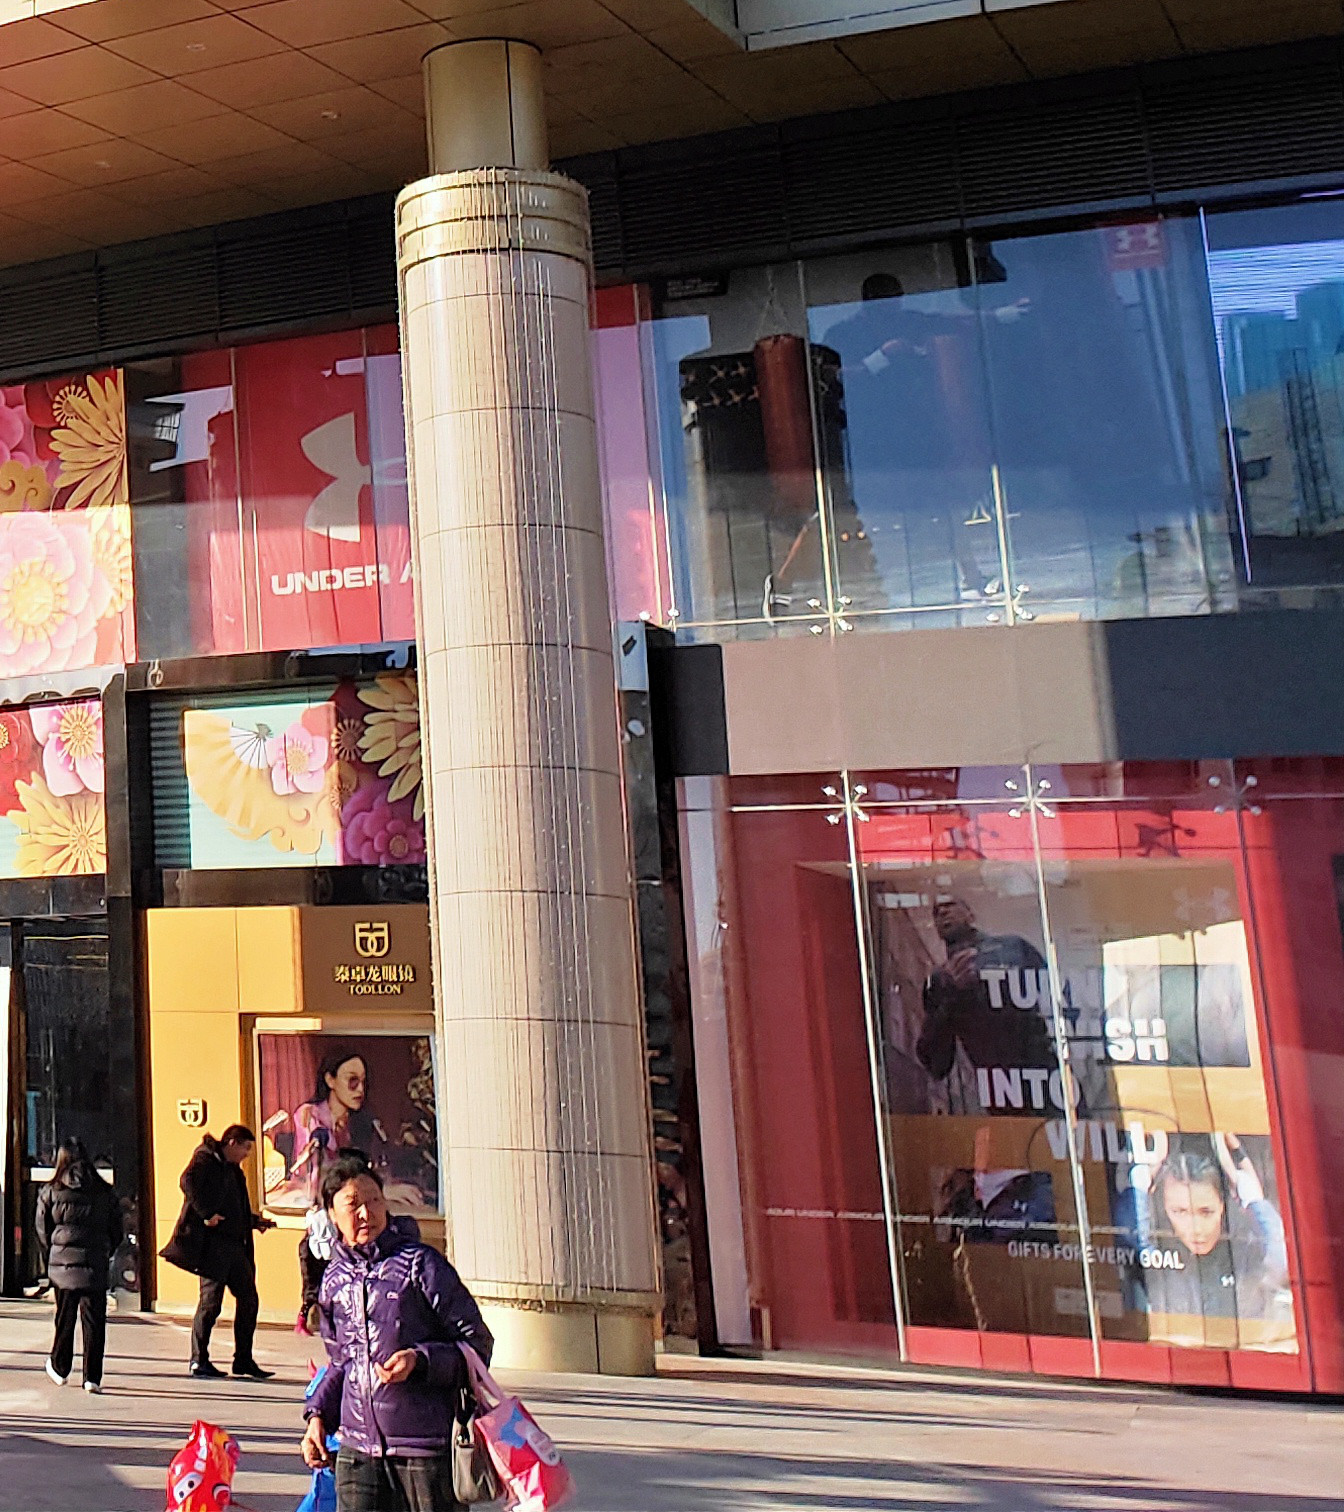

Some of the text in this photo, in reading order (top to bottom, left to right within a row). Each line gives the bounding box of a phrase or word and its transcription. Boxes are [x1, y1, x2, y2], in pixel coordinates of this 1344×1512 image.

[271, 562, 391, 595] UNDER
[350, 984, 401, 996] TODLLON
[977, 1067, 1081, 1112] INTO
[1045, 1119, 1169, 1165] WILD
[1008, 1241, 1051, 1260] GIFTS
[1086, 1245, 1136, 1266] EVERY
[1140, 1250, 1185, 1270] GOAL
